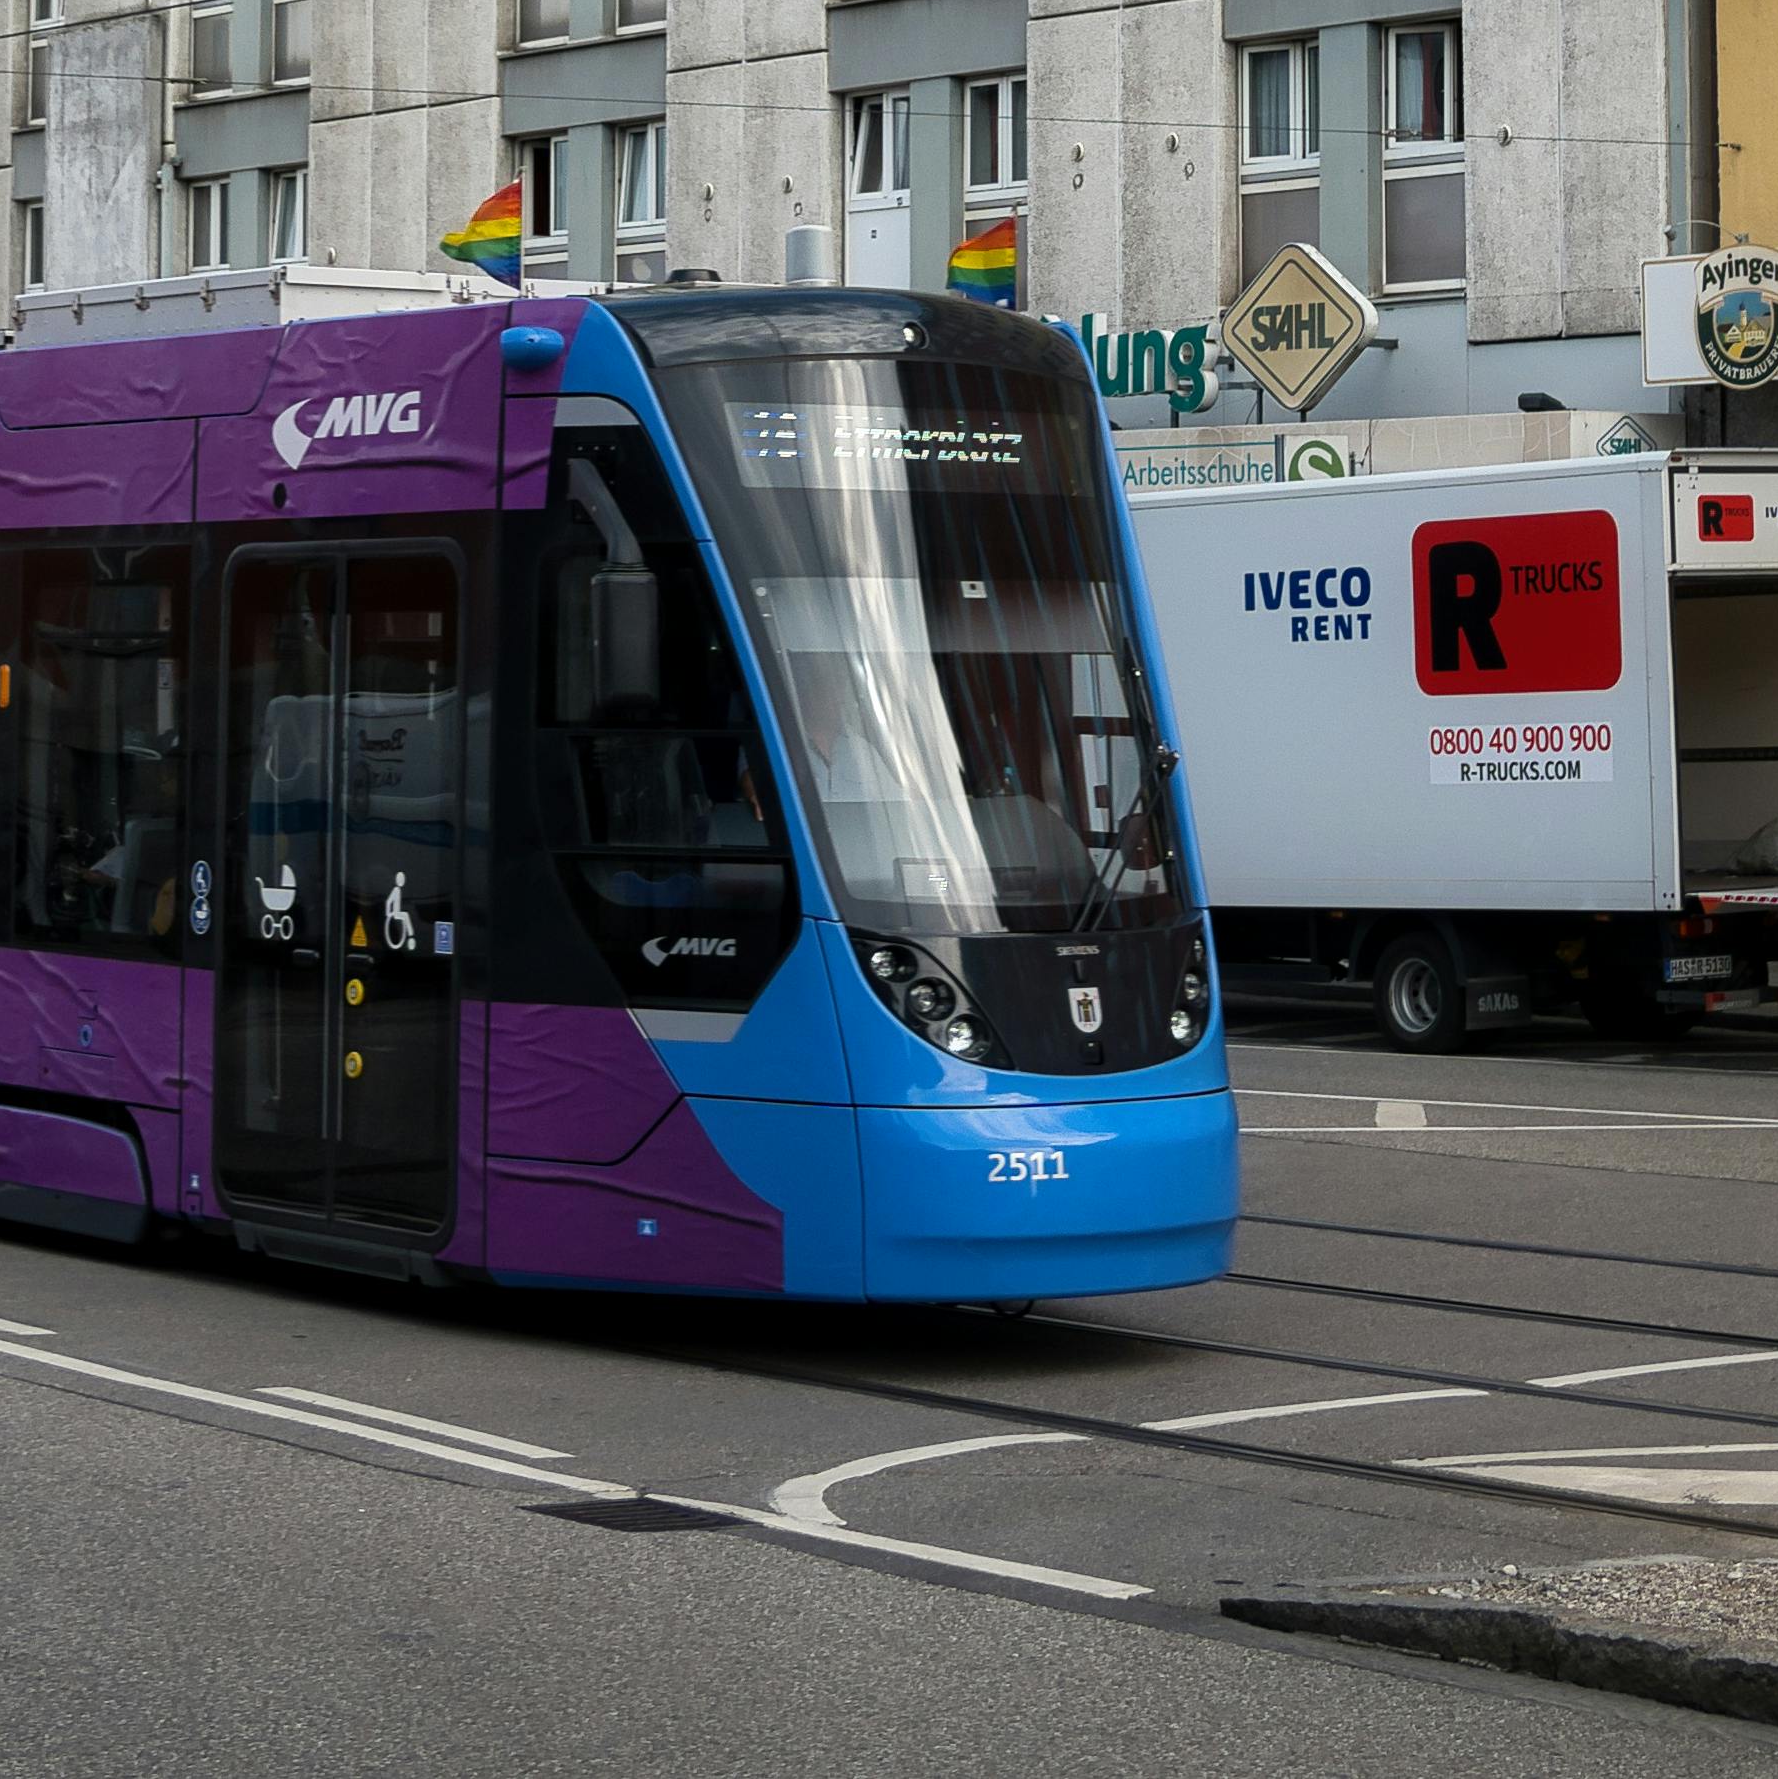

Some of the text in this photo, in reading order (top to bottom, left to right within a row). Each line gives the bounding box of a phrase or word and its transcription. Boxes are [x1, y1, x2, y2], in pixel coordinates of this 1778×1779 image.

[1251, 302, 1334, 352] STAHL
[313, 390, 421, 440] MVG
[1123, 452, 1274, 487] Arbeitsschuhe
[1701, 500, 1750, 537] R TRUCKS
[1244, 566, 1372, 612] IVECO
[1428, 540, 1604, 673] R TRUCKS
[1291, 613, 1372, 643] RENT
[1430, 724, 1612, 755] 0800 40 900 900
[1460, 759, 1582, 782] R-TRUCKS.COM
[669, 937, 737, 957] MVG
[1055, 944, 1100, 956] SIEMENS
[1477, 992, 1520, 1012] SAXAS
[987, 1149, 1069, 1182] 2511
